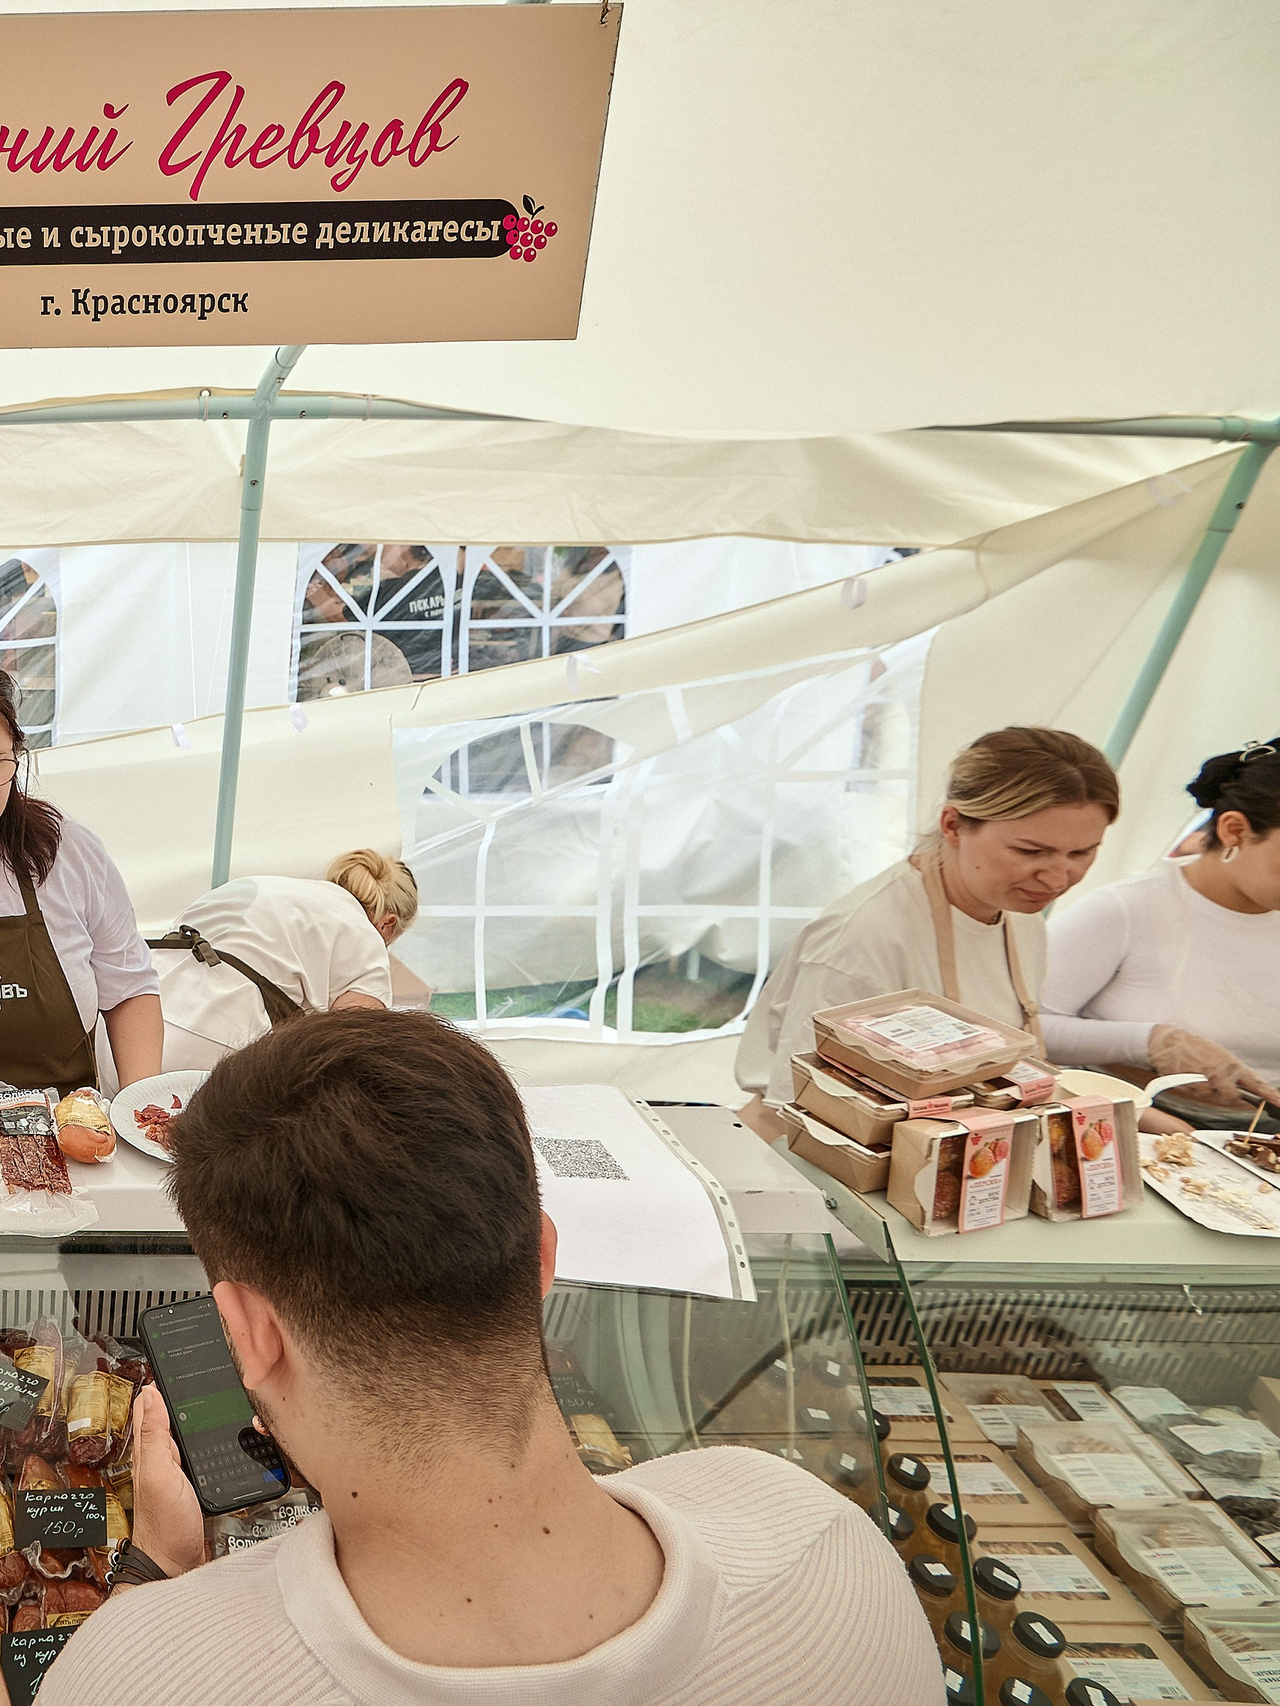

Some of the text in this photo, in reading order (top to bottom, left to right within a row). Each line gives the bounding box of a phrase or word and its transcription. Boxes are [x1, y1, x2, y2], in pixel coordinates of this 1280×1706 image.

[158, 70, 469, 201] Гревцов
[40, 226, 61, 248] и
[70, 222, 308, 255] сырокопченые
[315, 219, 503, 249] деликатесы
[40, 287, 249, 323] г. Красноярск
[26, 1505, 64, 1519] курин
